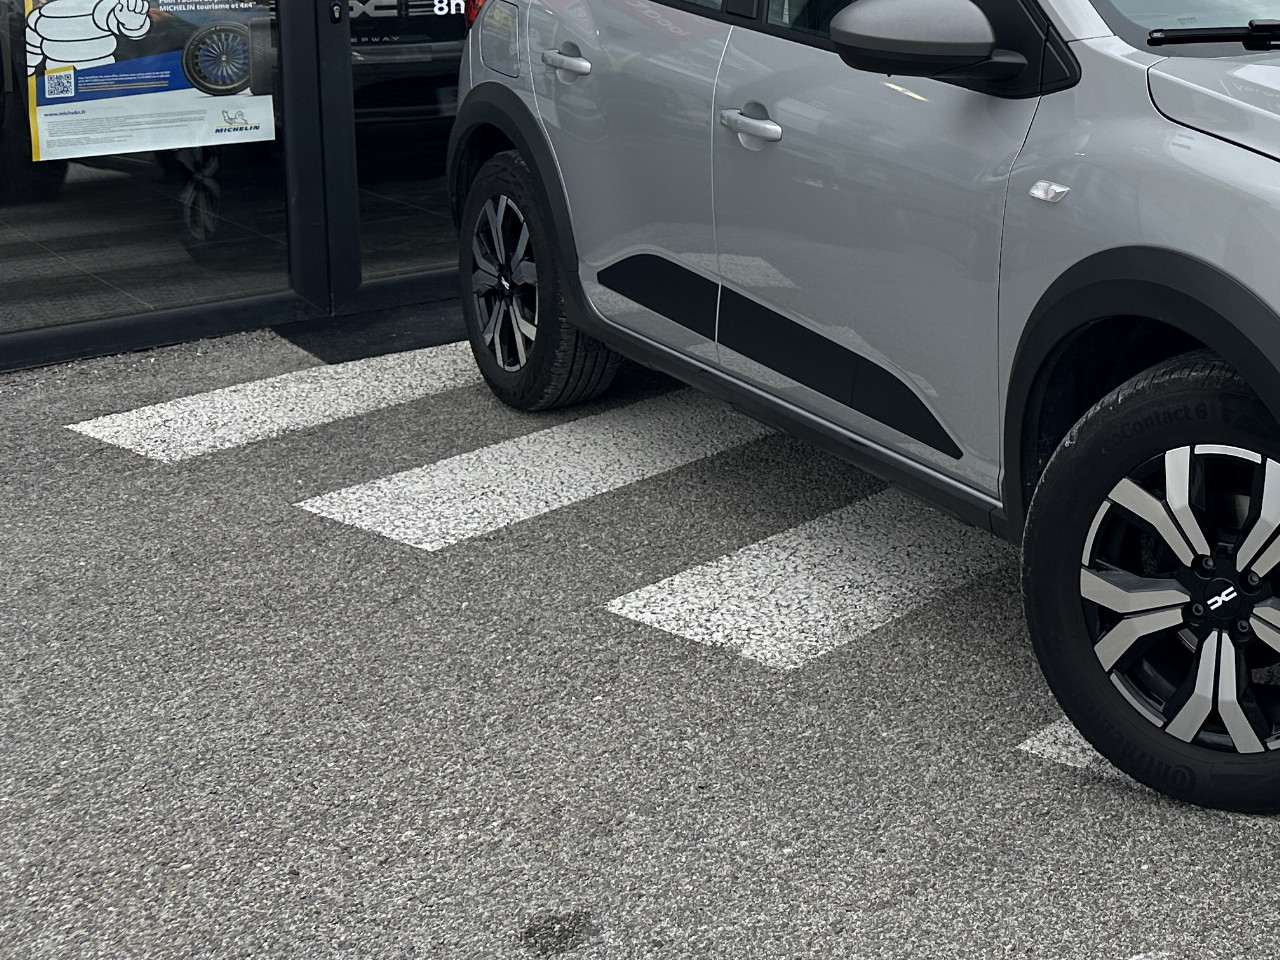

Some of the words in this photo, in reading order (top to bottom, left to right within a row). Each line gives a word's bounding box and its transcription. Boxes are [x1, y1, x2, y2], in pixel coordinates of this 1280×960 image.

[159, 3, 196, 12] MICHELIN
[196, 1, 230, 11] tourisme
[230, 2, 239, 10] et
[214, 125, 261, 134] MICHELIN
